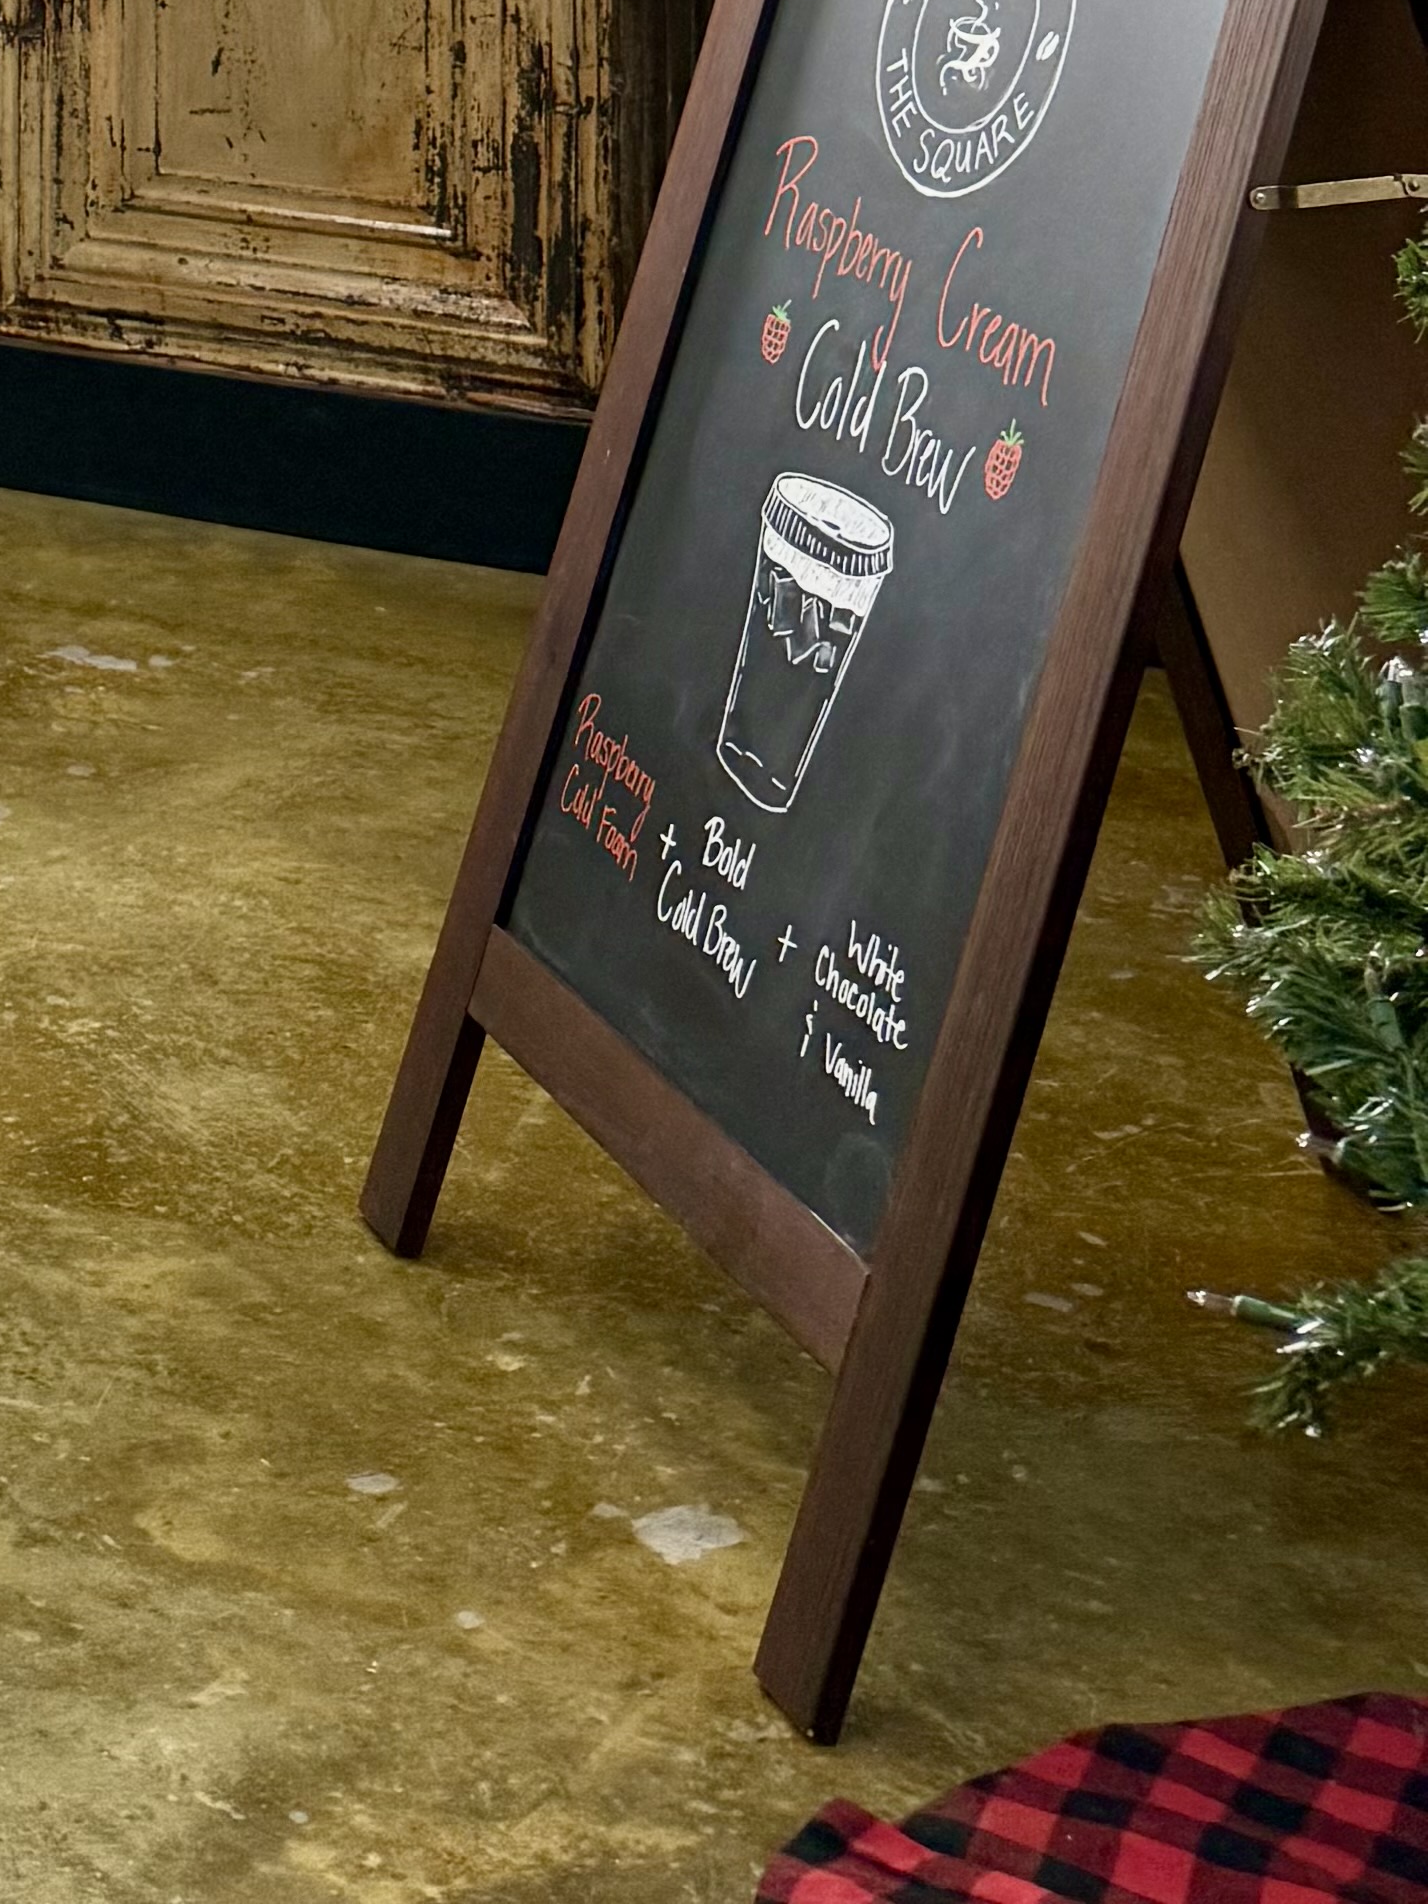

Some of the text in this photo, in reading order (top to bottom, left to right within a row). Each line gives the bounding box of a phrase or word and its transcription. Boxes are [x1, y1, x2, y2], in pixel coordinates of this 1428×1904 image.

[886, 47, 1035, 183] THE SQUARE
[763, 135, 1057, 407] Raspberry Cream
[795, 318, 977, 514] Cold Brew
[560, 763, 638, 882] Cold Foam
[702, 815, 757, 891] Bold
[657, 859, 757, 999] Cold Brew
[848, 919, 905, 1002] White
[815, 944, 909, 1050] Chocolate
[825, 1032, 878, 1126] Vanilla
